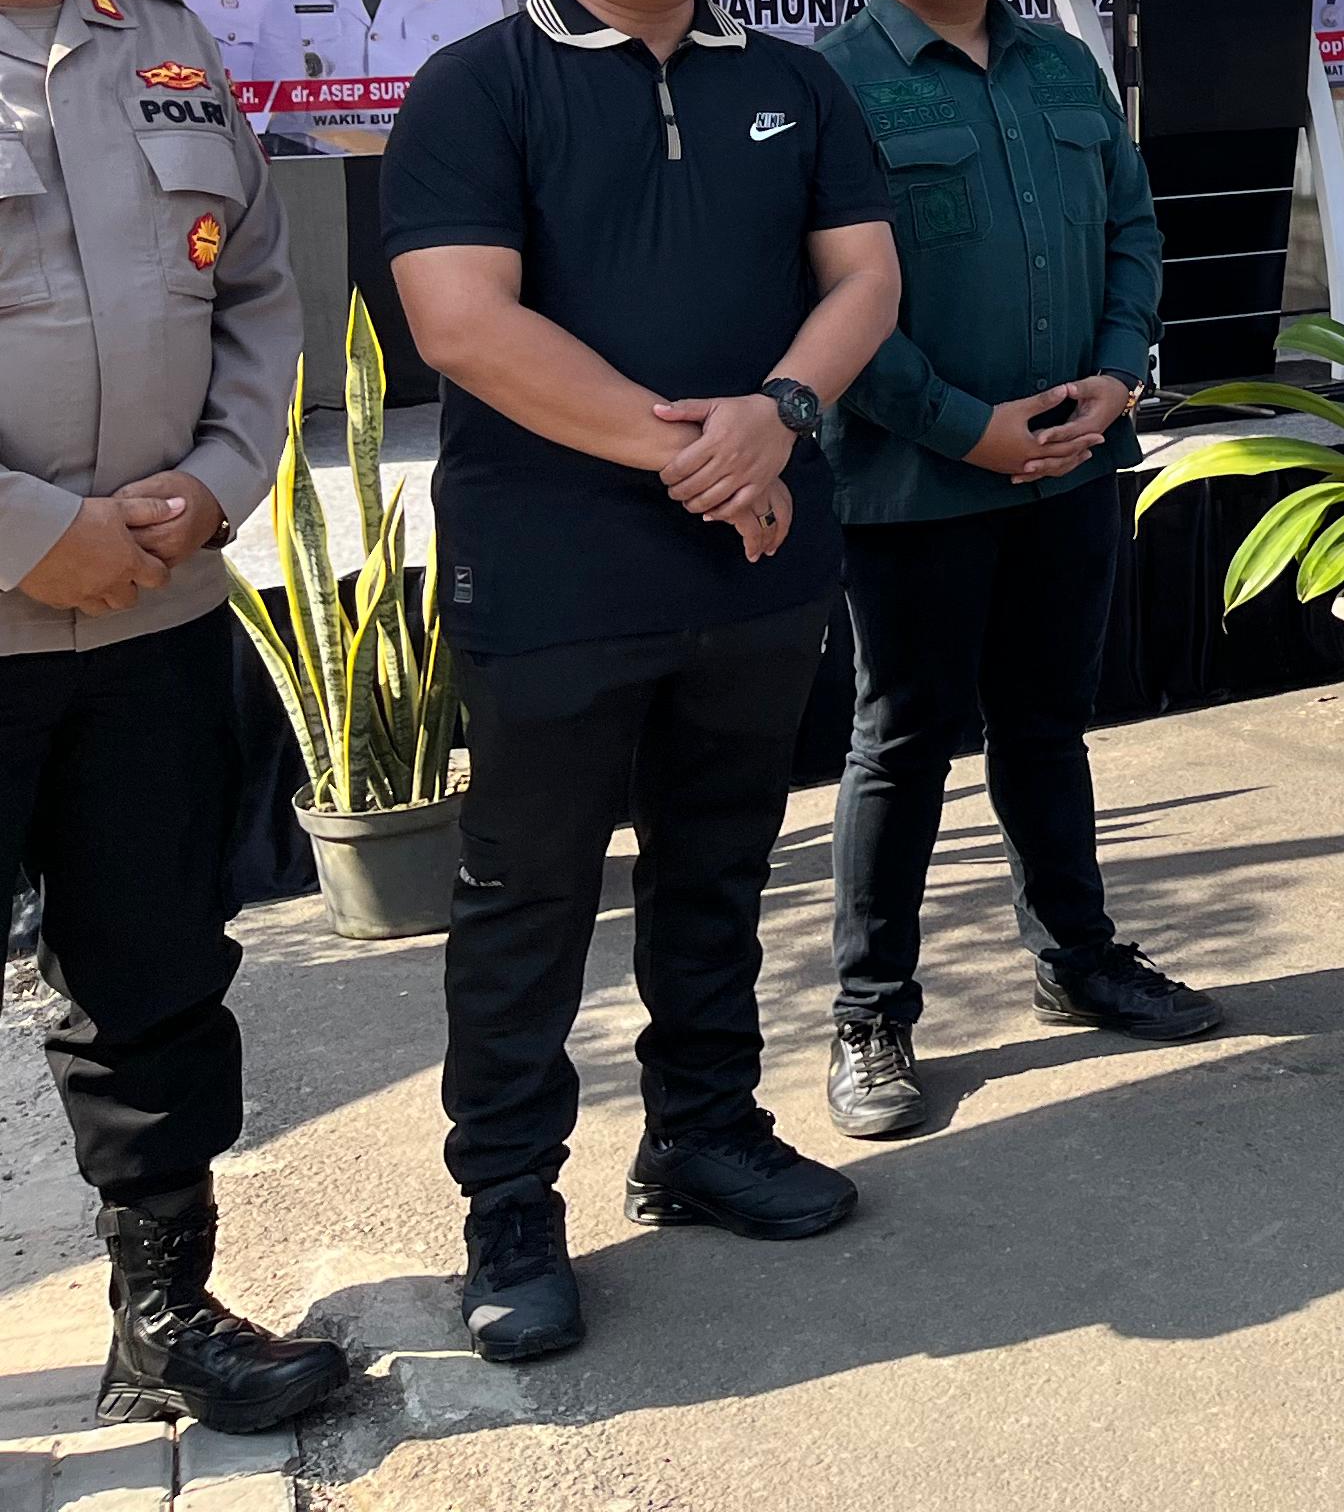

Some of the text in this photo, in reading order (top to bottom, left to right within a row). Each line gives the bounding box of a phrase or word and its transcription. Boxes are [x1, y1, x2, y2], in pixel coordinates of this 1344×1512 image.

[1325, 64, 1344, 76] MAT
[291, 81, 409, 104] dr. ASEP SUR
[140, 99, 226, 127] POLRI
[312, 114, 366, 126] WAKIL
[879, 102, 956, 131] SATRIO
